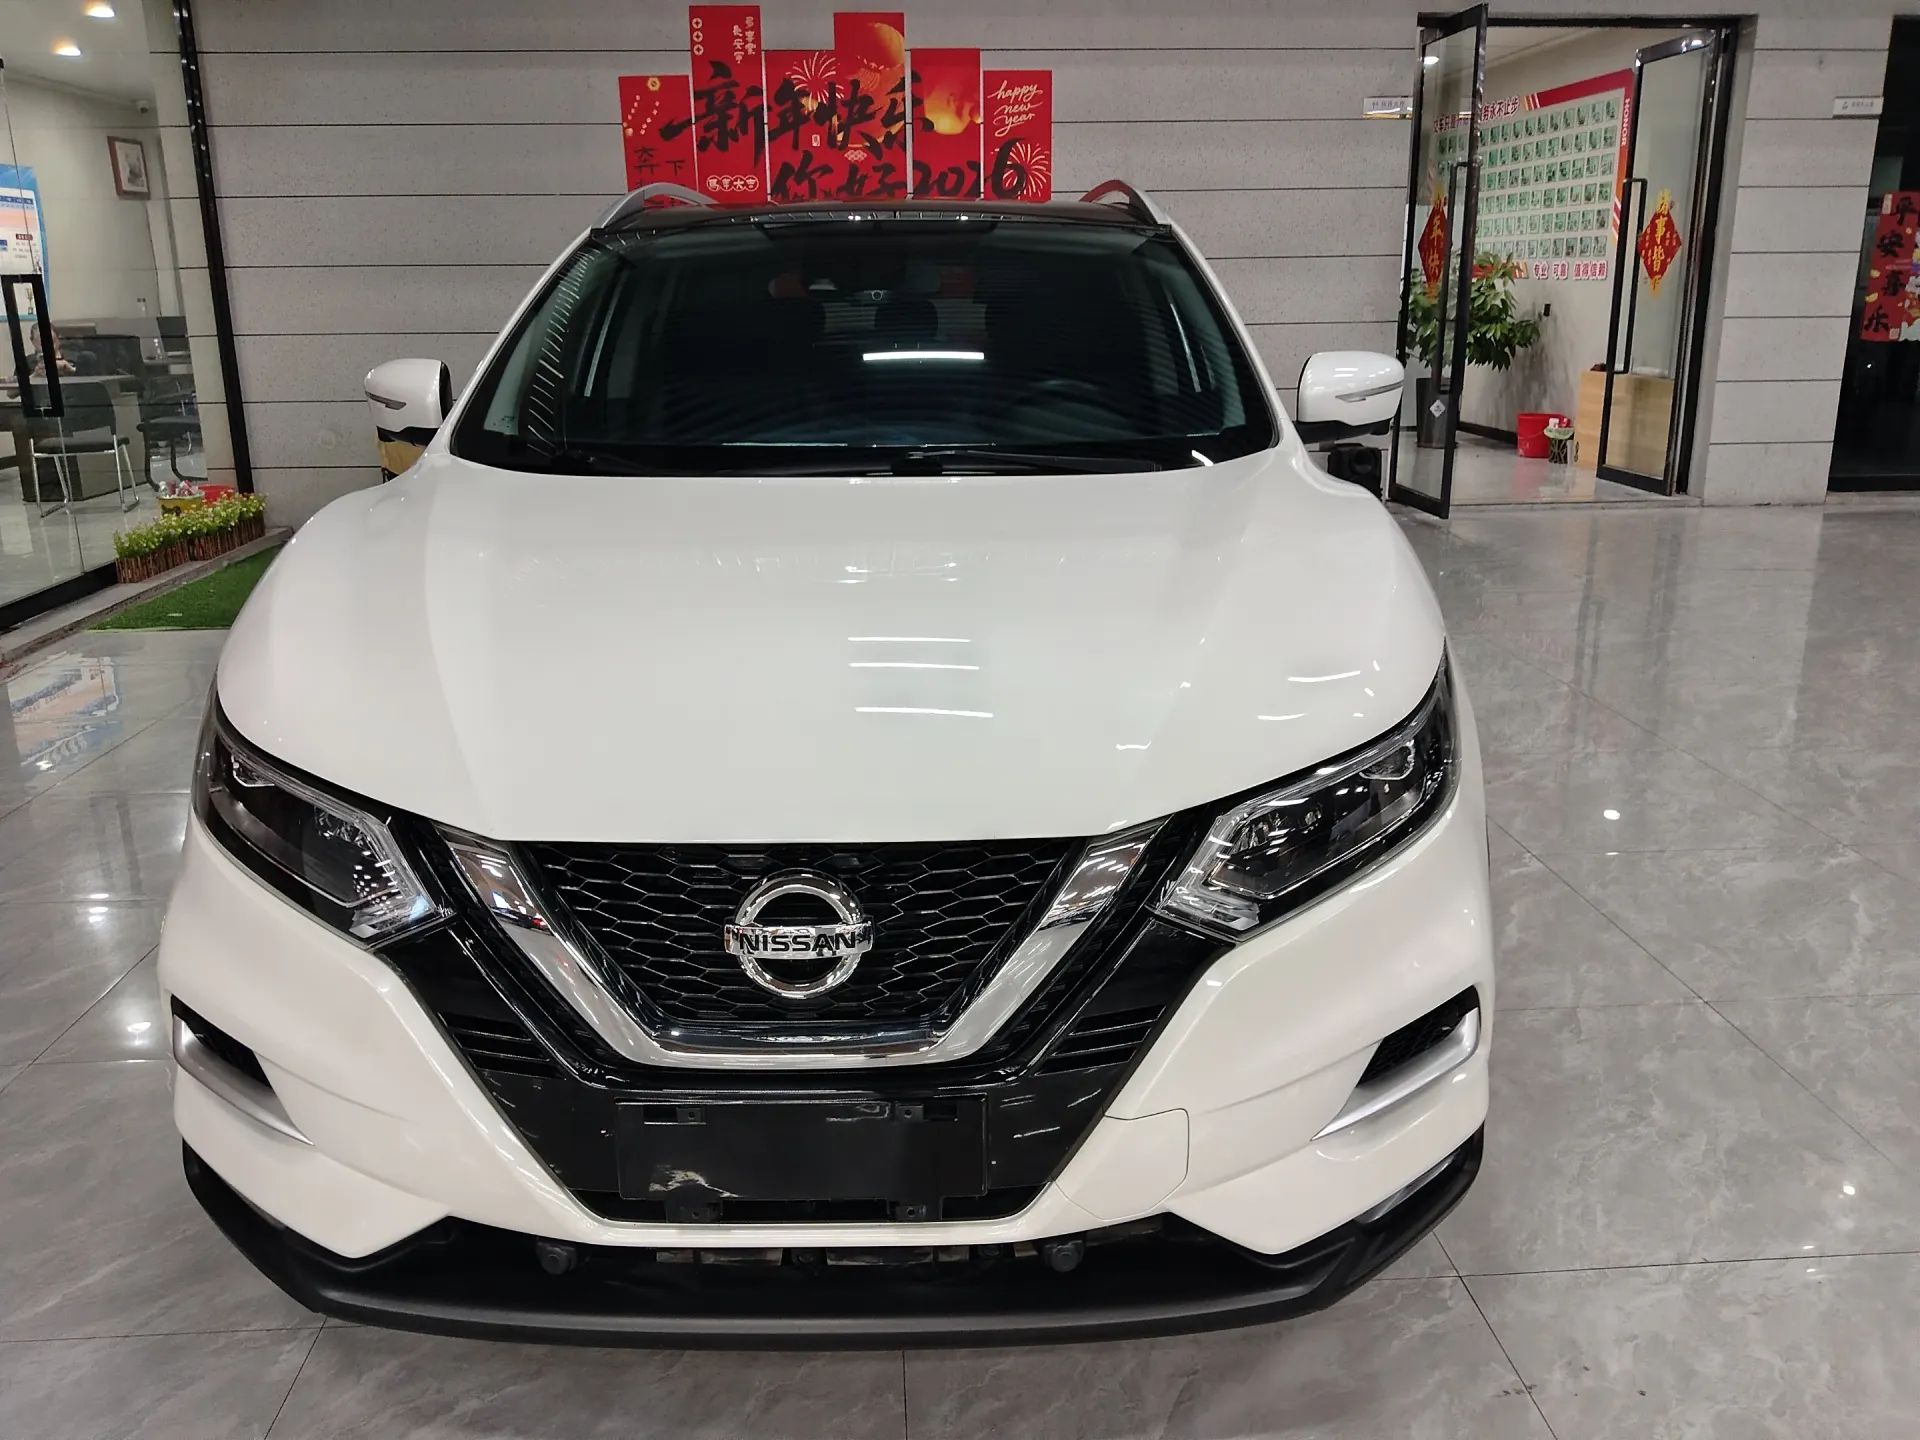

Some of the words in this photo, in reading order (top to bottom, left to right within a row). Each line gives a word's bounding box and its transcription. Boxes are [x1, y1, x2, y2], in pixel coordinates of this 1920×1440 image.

[987, 80, 1043, 103] happy
[994, 101, 1043, 116] new
[993, 113, 1035, 137] year
[1620, 97, 1631, 147] HONOR
[739, 932, 856, 953] NISSAN
